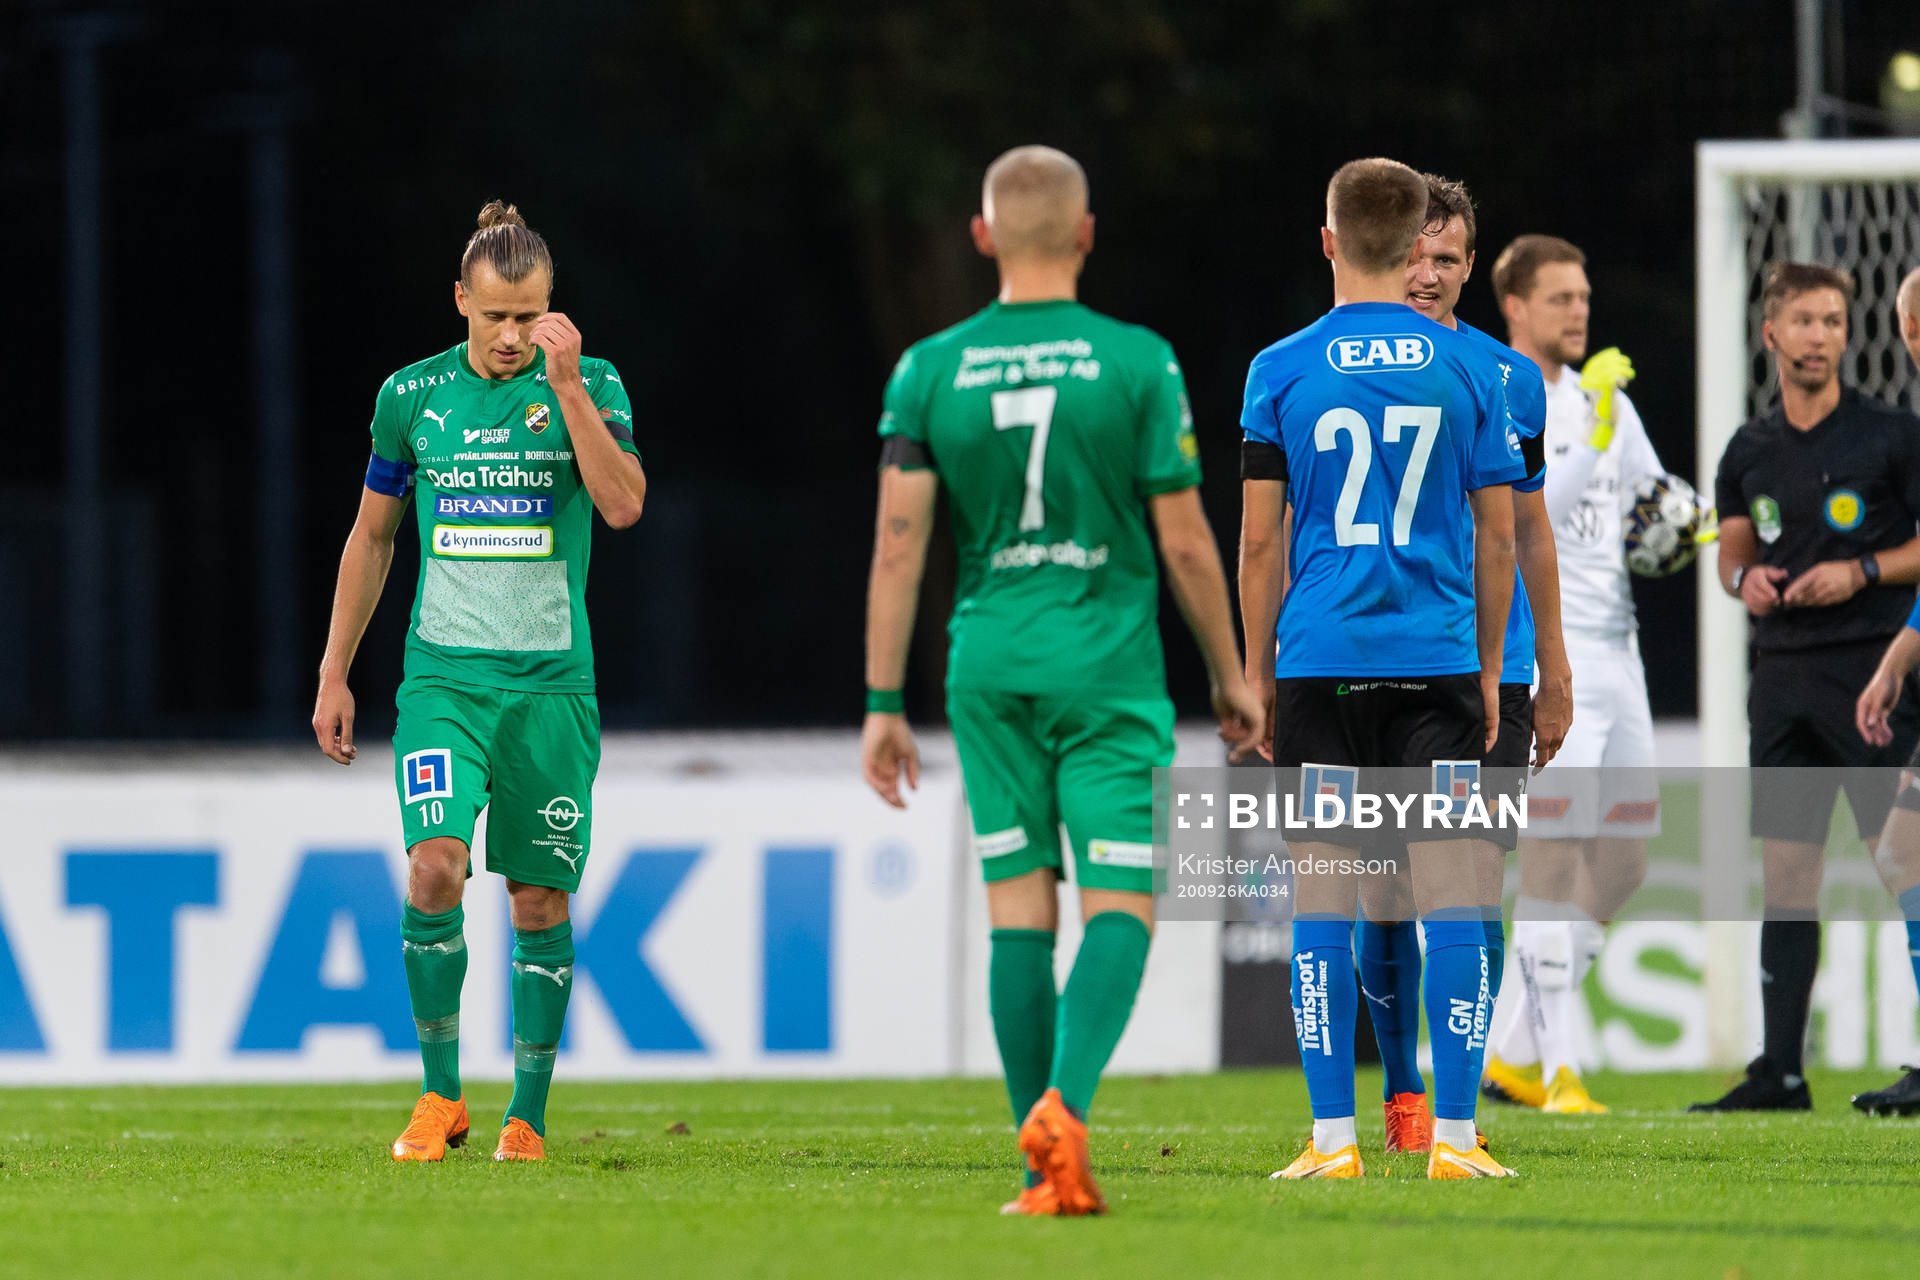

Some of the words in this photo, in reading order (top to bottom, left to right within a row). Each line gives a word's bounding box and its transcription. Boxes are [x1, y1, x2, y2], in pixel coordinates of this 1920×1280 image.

[1338, 338, 1424, 368] EAB
[396, 370, 457, 396] BRIXLY
[481, 428, 510, 438] INTER
[481, 436, 510, 444] SPORT
[416, 455, 450, 464] OOTBALL
[991, 385, 1057, 533] 7
[426, 466, 476, 488] Dala
[478, 464, 553, 488] Trähus
[1314, 405, 1442, 547] 27
[439, 499, 547, 513] BRANDT
[453, 533, 543, 548] kynningsrud
[1350, 684, 1368, 692] PART
[419, 800, 444, 828] 10
[547, 833, 570, 842] NANNY
[1295, 951, 1320, 1052] Transport
[1447, 997, 1475, 1035] GN
